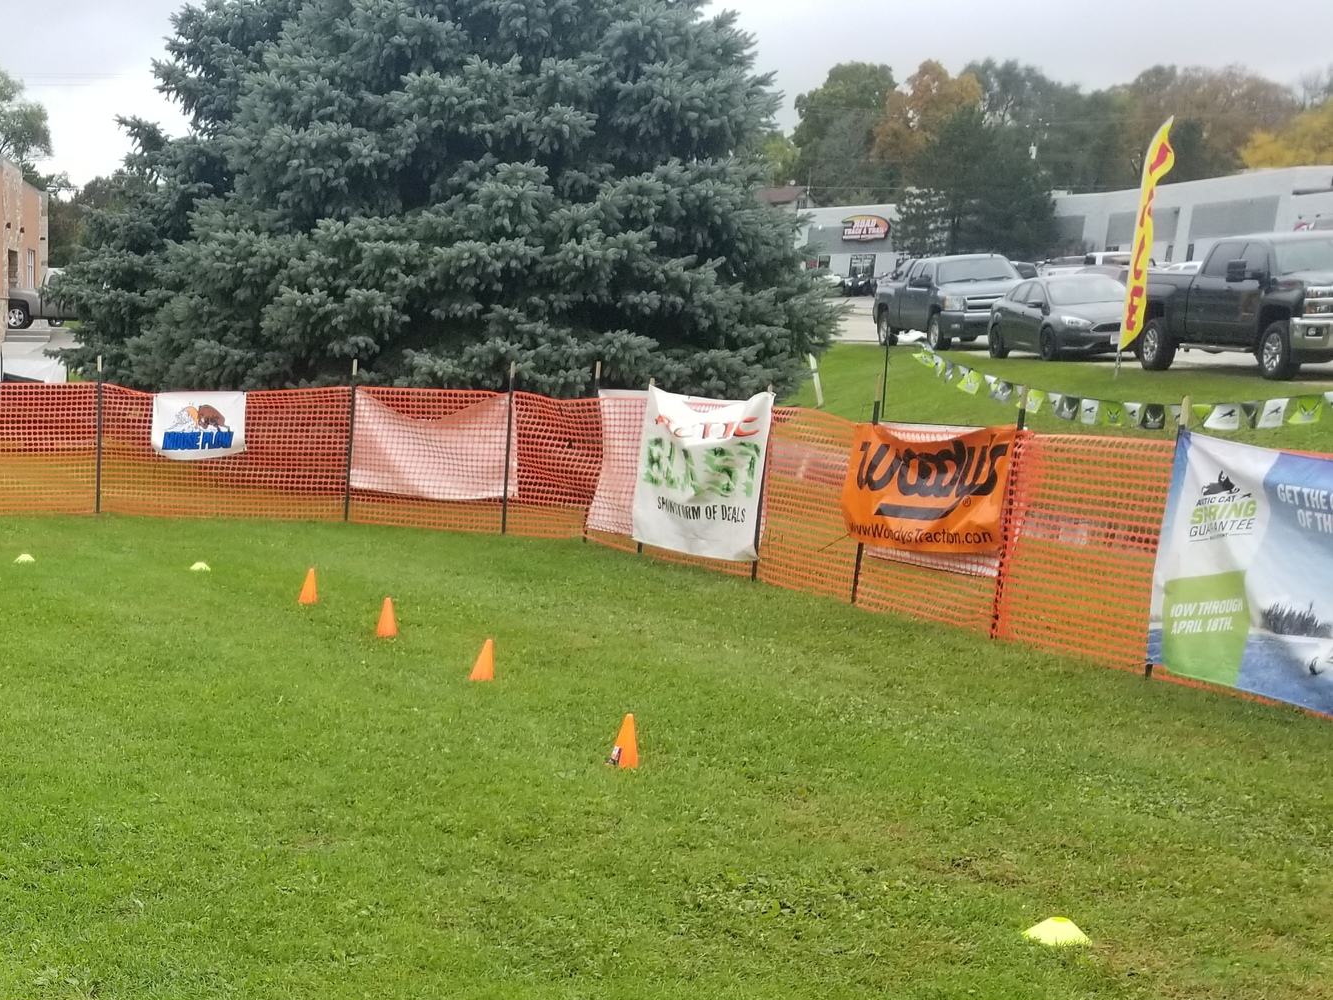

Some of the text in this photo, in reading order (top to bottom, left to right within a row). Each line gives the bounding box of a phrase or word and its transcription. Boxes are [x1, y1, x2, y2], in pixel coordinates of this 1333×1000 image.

[201, 431, 234, 450] PLOW
[1218, 495, 1237, 503] CAT
[1277, 483, 1301, 506] GET
[1302, 487, 1328, 510] THE
[705, 505, 717, 520] OF
[721, 504, 746, 523] DEALS
[1297, 509, 1333, 534] OF TH
[1170, 619, 1203, 635] APRIL
